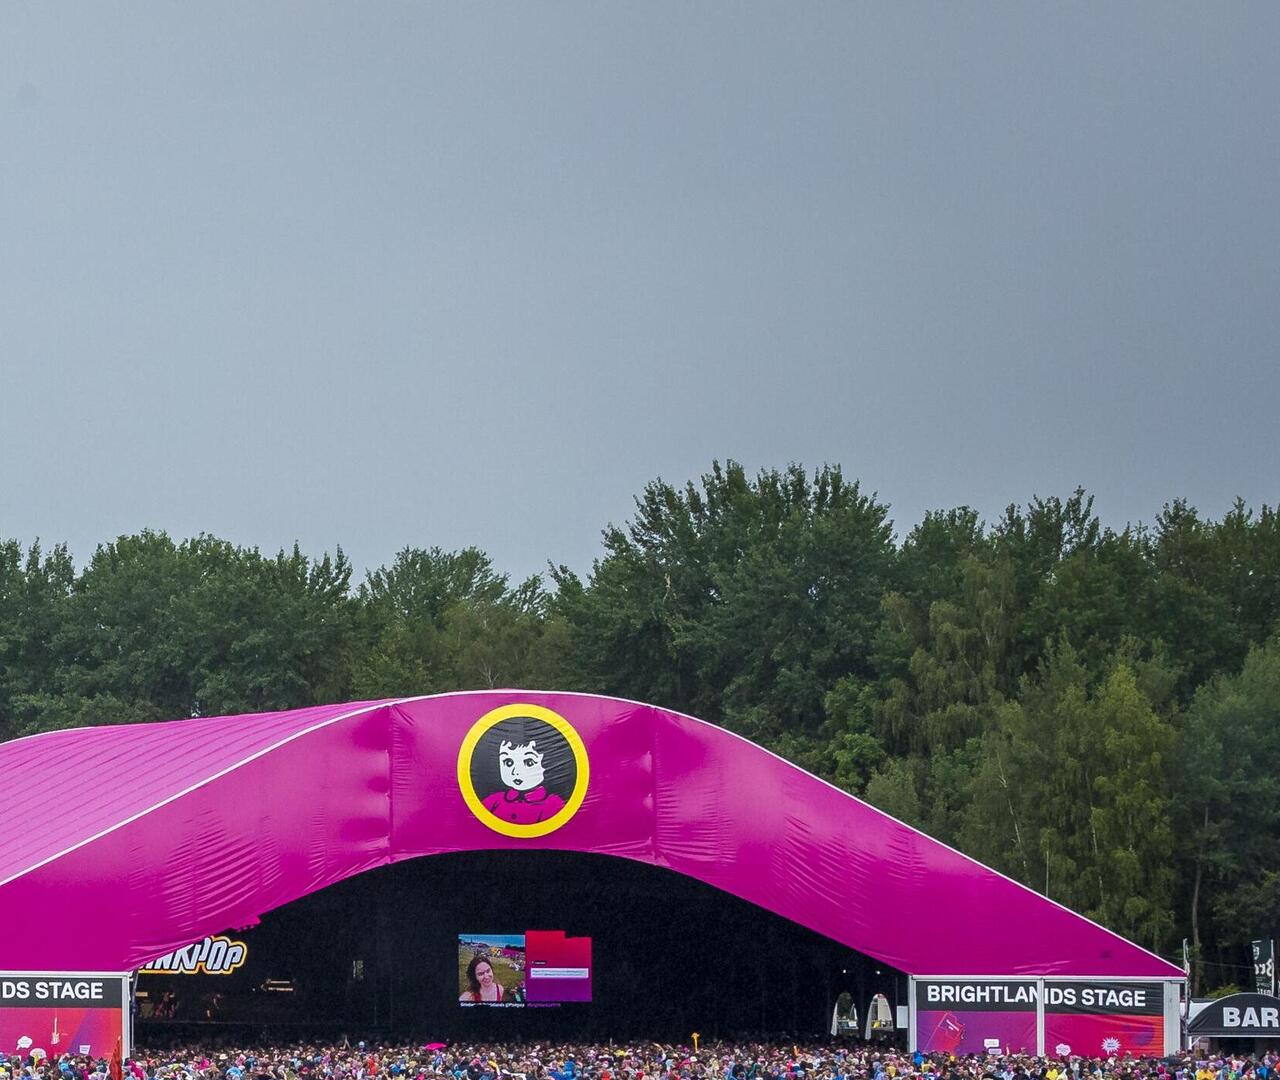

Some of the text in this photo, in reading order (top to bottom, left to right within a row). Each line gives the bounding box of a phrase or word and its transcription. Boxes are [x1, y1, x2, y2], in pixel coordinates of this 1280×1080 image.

[35, 981, 104, 999] STAGE
[927, 985, 1147, 1007] BRIGHTLANDS STAGE
